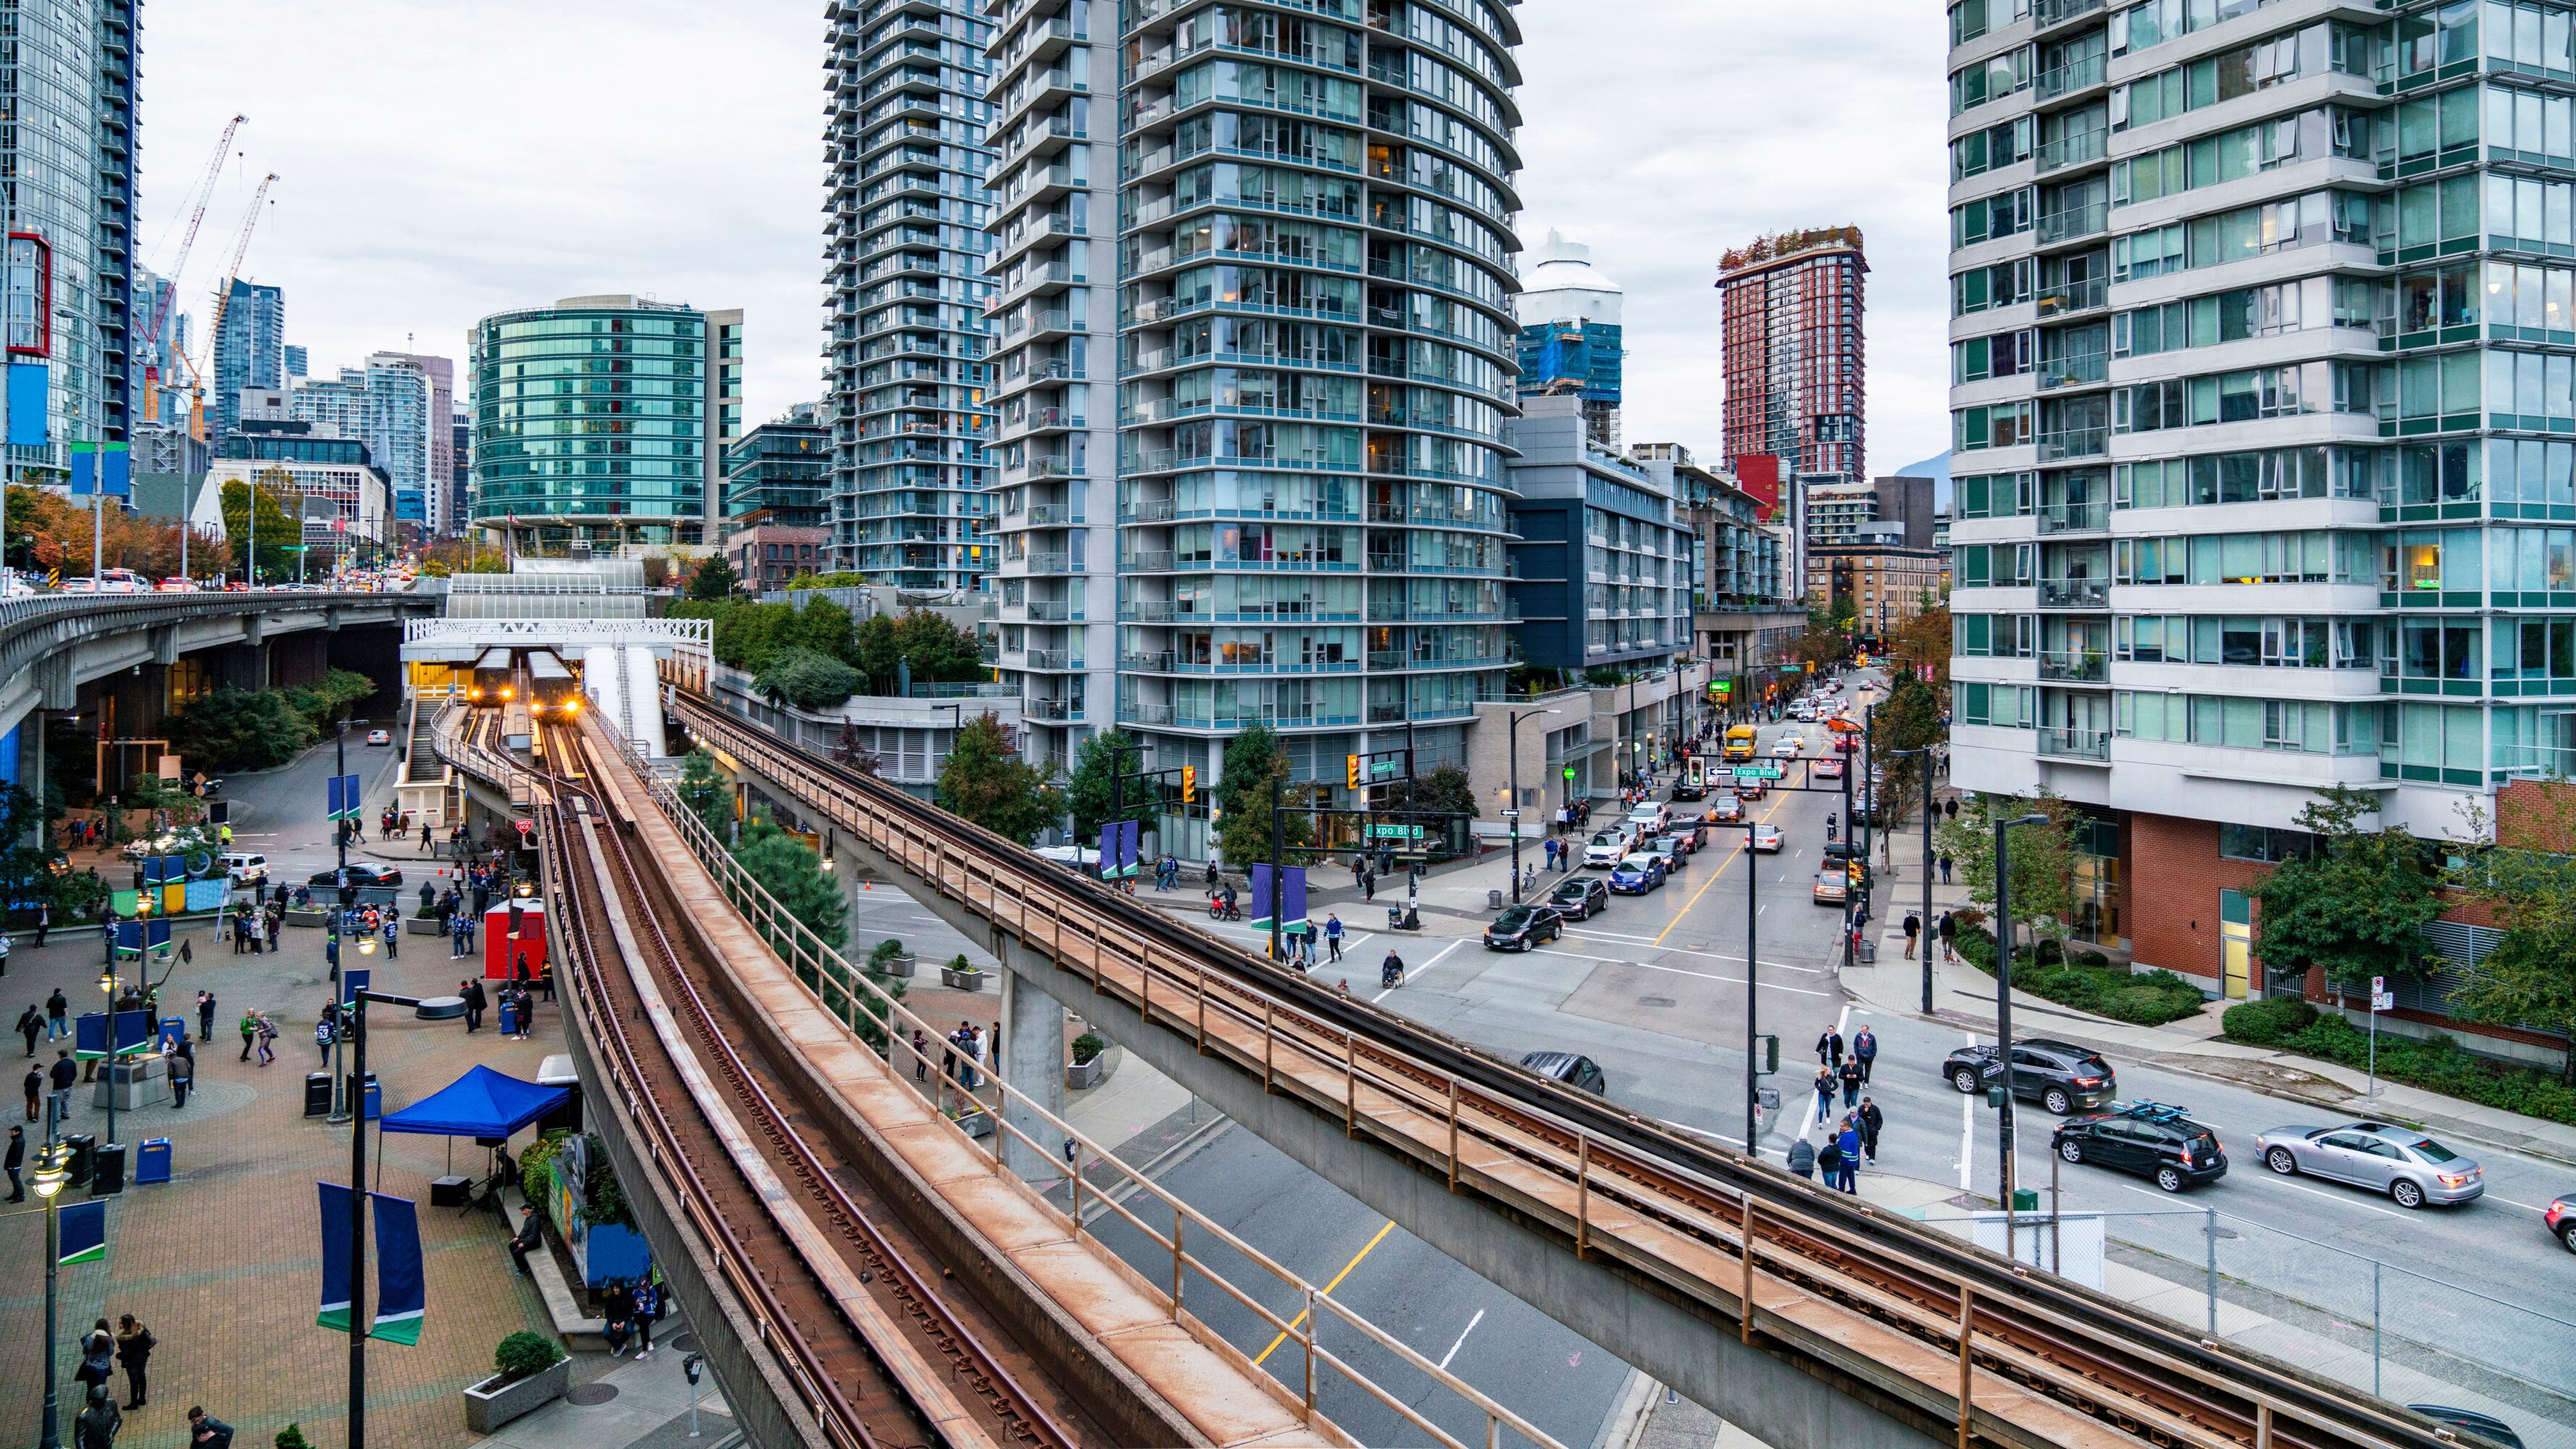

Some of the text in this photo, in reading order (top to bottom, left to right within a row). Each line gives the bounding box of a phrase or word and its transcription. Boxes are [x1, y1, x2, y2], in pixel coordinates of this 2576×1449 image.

[1373, 763, 1388, 772] Abbott
[1738, 768, 1756, 777] Expo
[1372, 827, 1393, 836] xpo
[318, 1028, 329, 1039] 53
